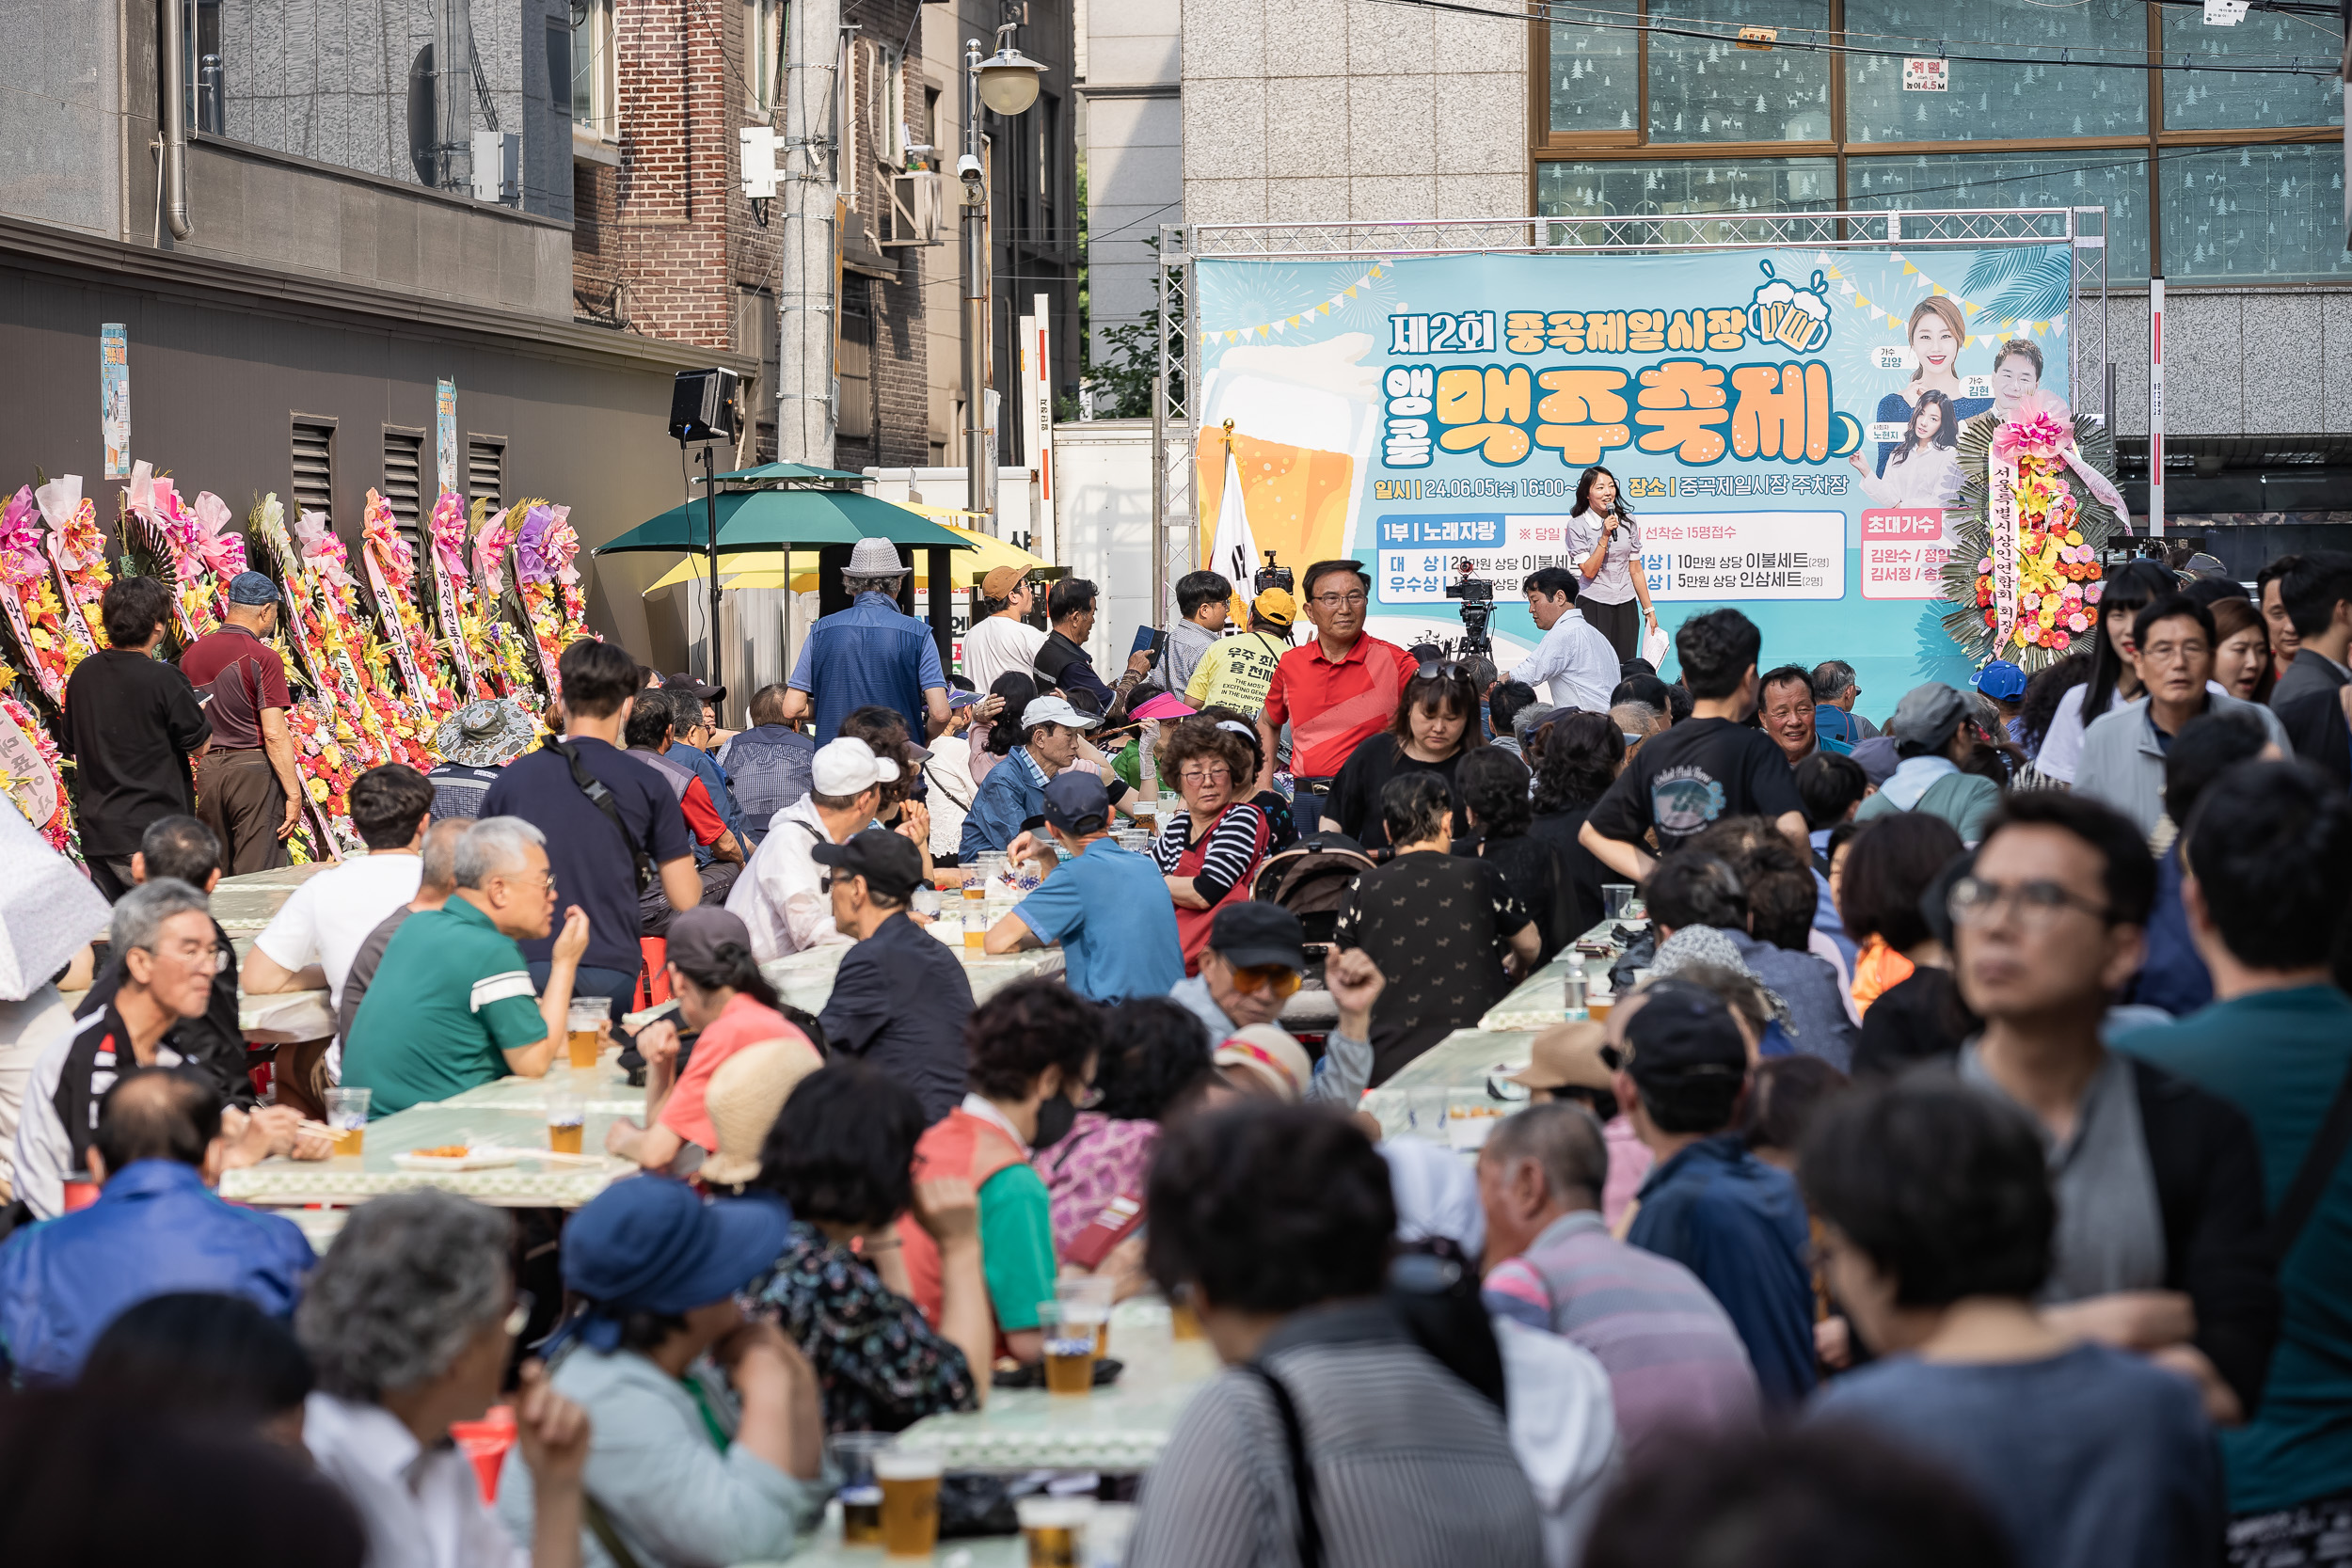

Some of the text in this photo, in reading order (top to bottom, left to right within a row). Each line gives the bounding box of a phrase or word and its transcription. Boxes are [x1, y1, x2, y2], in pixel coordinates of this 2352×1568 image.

[1912, 61, 1940, 73] 위험
[1390, 309, 1747, 355] 제2회 중곡제일시장
[1882, 348, 1896, 356] 가수
[1882, 356, 1902, 368] 김양
[1969, 386, 1990, 397] 김현
[1041, 398, 1049, 431] 일단정지
[1383, 365, 1435, 467] 앵콜
[1435, 360, 1832, 467] 맥주축제
[1873, 431, 1899, 440] 노현지
[1375, 480, 1410, 499] 일시
[1425, 479, 1518, 499] 24.06.05(수)
[1629, 474, 1850, 498] 장소 중곡제일시장 주차장
[1383, 521, 1497, 542] 1부 노래자랑
[1867, 515, 1935, 534] 초대가수
[1535, 528, 1561, 541] 당일
[1645, 526, 1737, 540] 선착순 15명접수
[1677, 554, 1716, 569] 10만원
[1719, 556, 1743, 569] 상당
[1871, 548, 1912, 563] 김완수
[1495, 558, 1518, 571] 상당
[1677, 574, 1709, 588] 5만원
[1713, 575, 1737, 587] 상당
[1871, 567, 1912, 581] 김서정
[1391, 575, 1439, 593] 우수상
[1495, 578, 1518, 591] 상당
[1228, 647, 1256, 660] 우주
[1230, 661, 1246, 673] 흥
[1223, 683, 1250, 693] EXCITING
[1235, 678, 1247, 687] THE
